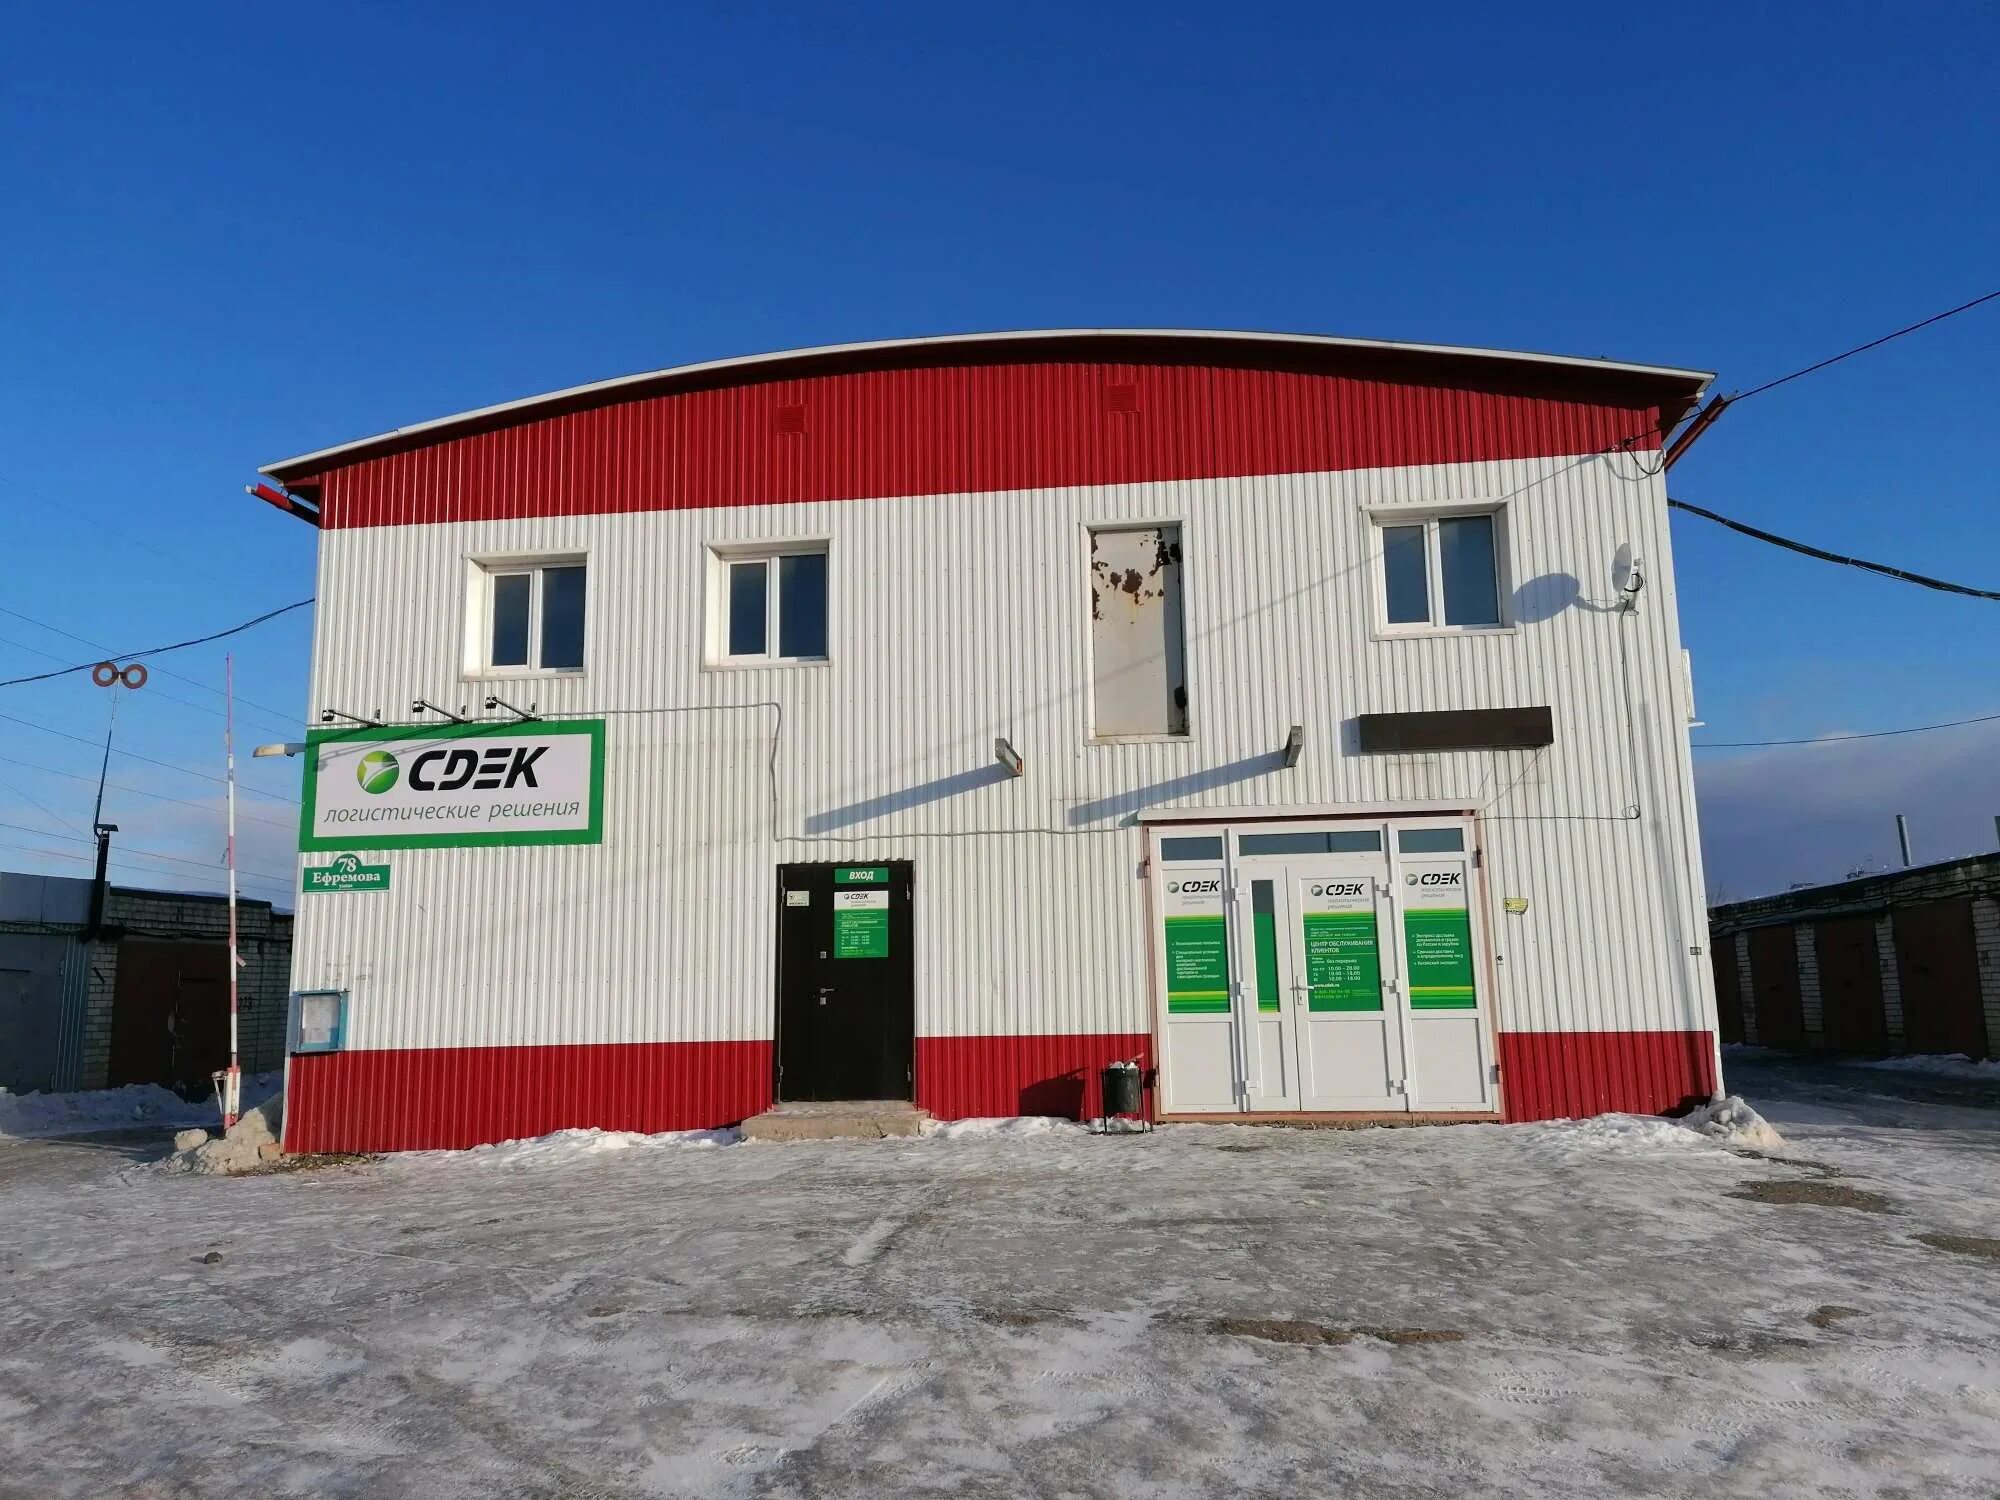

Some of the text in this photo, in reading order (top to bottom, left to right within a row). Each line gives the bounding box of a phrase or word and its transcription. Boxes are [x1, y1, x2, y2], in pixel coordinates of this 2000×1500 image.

[408, 746, 551, 791] CDEK
[324, 801, 580, 823] логистические решения
[338, 857, 357, 873] 78
[312, 871, 381, 886] Ефремова
[849, 870, 874, 881] ВХОД
[1420, 872, 1461, 885] CDEK
[1181, 880, 1220, 893] CDEK
[1325, 883, 1364, 896] CDEK
